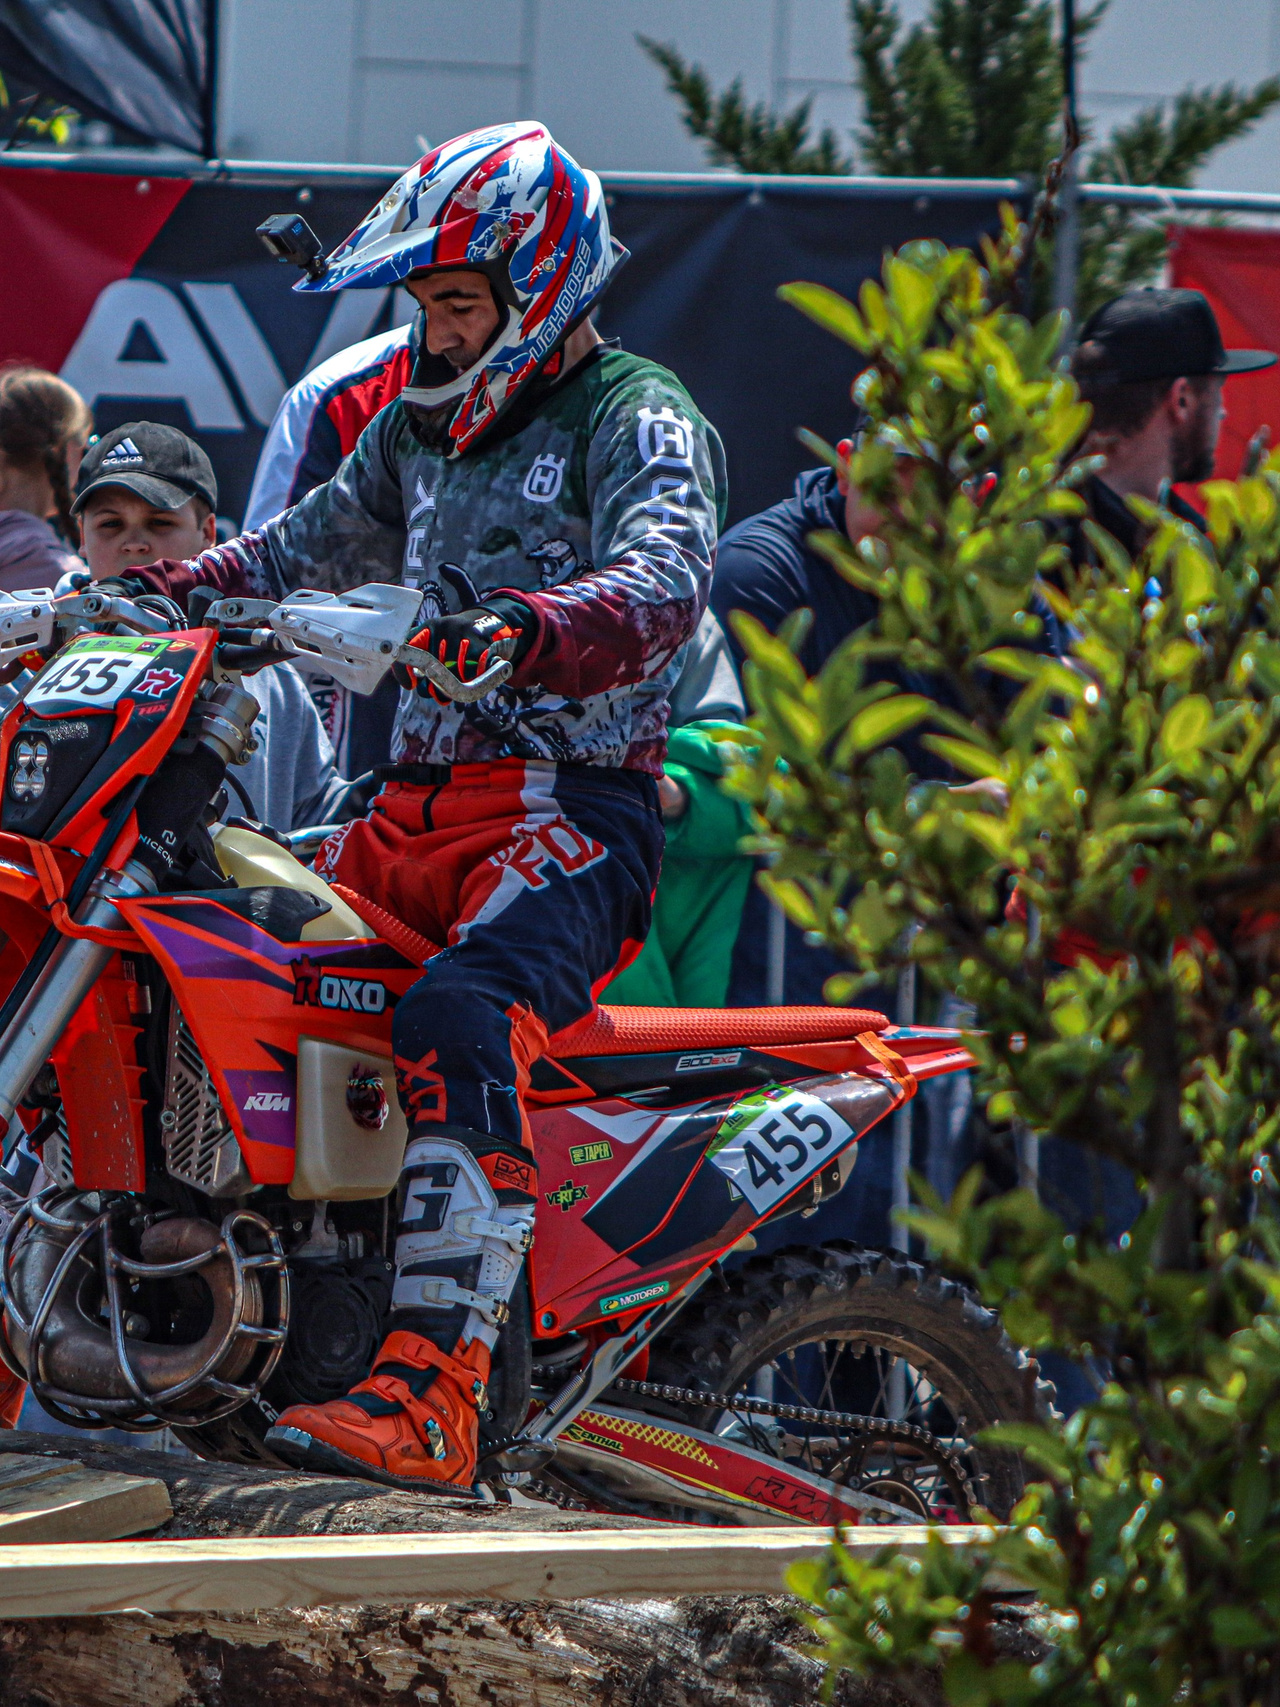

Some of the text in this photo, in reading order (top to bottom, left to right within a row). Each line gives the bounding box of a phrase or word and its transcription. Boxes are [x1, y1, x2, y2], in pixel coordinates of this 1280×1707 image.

[472, 614, 502, 634] KTM
[37, 657, 133, 696] 455
[243, 1092, 291, 1112] KTM
[584, 1143, 610, 1161] TAPER
[742, 1101, 833, 1190] 455
[545, 1184, 590, 1207] VERTEX
[619, 1285, 665, 1306] MOTOREX
[743, 1475, 832, 1526] KTM
